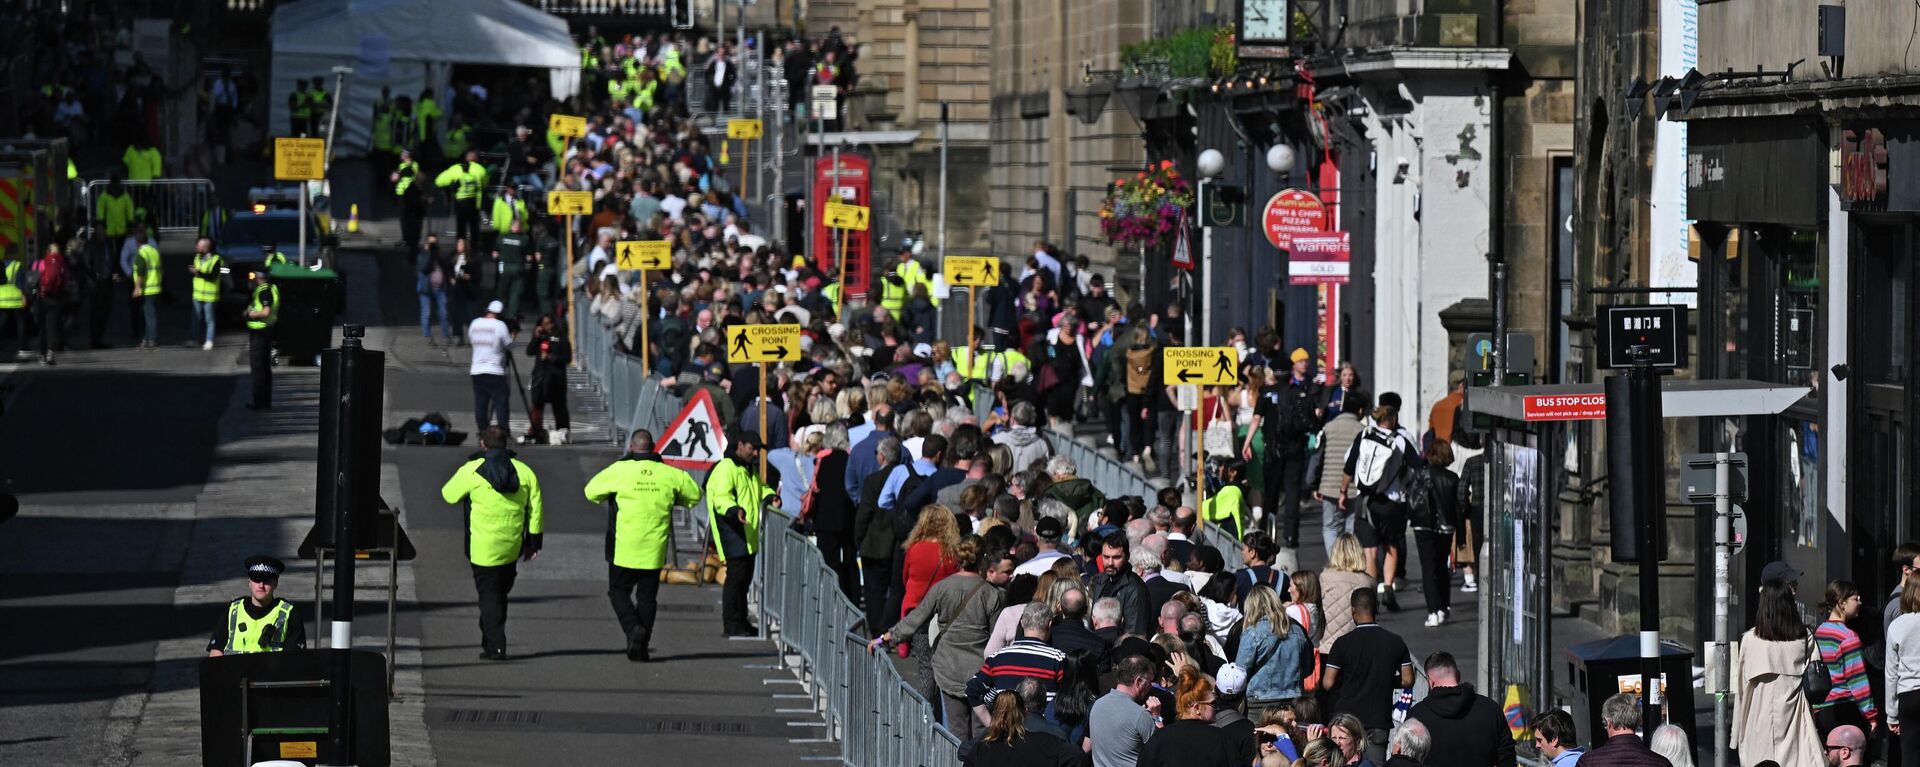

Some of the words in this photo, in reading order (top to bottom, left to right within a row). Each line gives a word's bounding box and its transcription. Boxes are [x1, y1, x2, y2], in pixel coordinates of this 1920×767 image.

[1291, 209, 1297, 217] &
[1282, 217, 1310, 225] PIZZAS
[1272, 224, 1319, 233] SHAWARMA
[1296, 242, 1350, 252] warners
[752, 326, 799, 336] CROSSING
[762, 336, 788, 344] POINT
[1166, 349, 1214, 358] CROSSING
[1176, 359, 1204, 367] POINT
[1536, 397, 1555, 407] BUS
[1556, 396, 1580, 406] STOP
[1562, 410, 1573, 418] pick
[1583, 409, 1593, 417] drop
